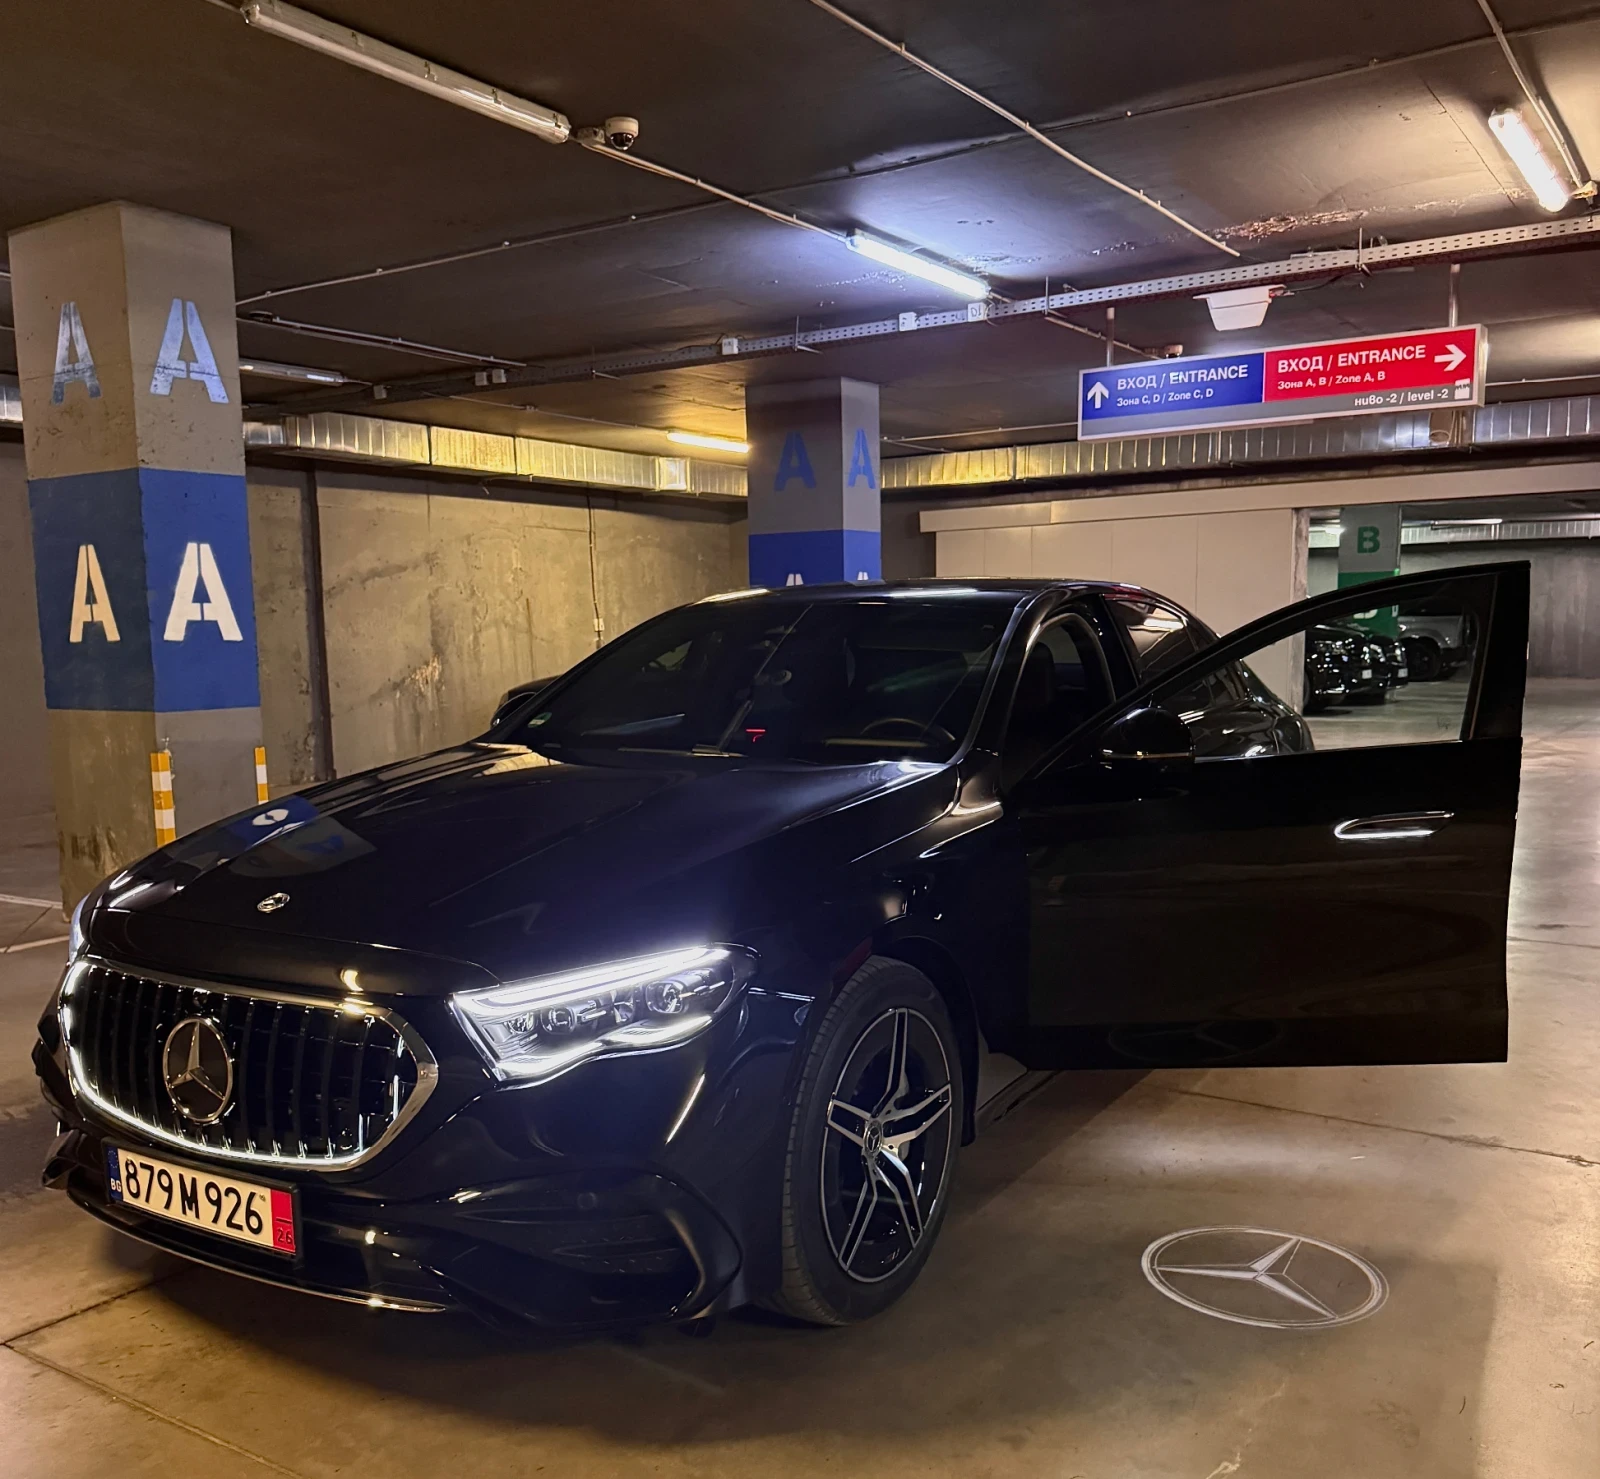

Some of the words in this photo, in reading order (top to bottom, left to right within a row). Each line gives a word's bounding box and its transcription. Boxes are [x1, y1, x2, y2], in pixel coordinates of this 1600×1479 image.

[52, 302, 102, 404] A
[150, 298, 230, 404] A
[1277, 356, 1323, 373] ВХОД
[1337, 344, 1426, 367] ENTRANCE
[1117, 375, 1157, 391] ВХОД
[1169, 364, 1249, 385] ENTRANCE
[1277, 380, 1303, 390] Зона
[1335, 373, 1361, 384] Zone
[1377, 371, 1386, 380] B
[1116, 397, 1140, 407] Зона
[1153, 394, 1160, 403] D
[1168, 391, 1191, 402] Zone
[1206, 388, 1214, 397] D
[1385, 393, 1397, 404] -2
[1407, 389, 1434, 402] level
[1436, 388, 1449, 399] -2
[775, 432, 815, 491] A
[847, 428, 877, 490] A
[1357, 526, 1380, 553] B
[69, 543, 122, 644] A
[163, 542, 244, 643] A
[111, 1178, 122, 1192] BG
[277, 1228, 293, 1244] 26
